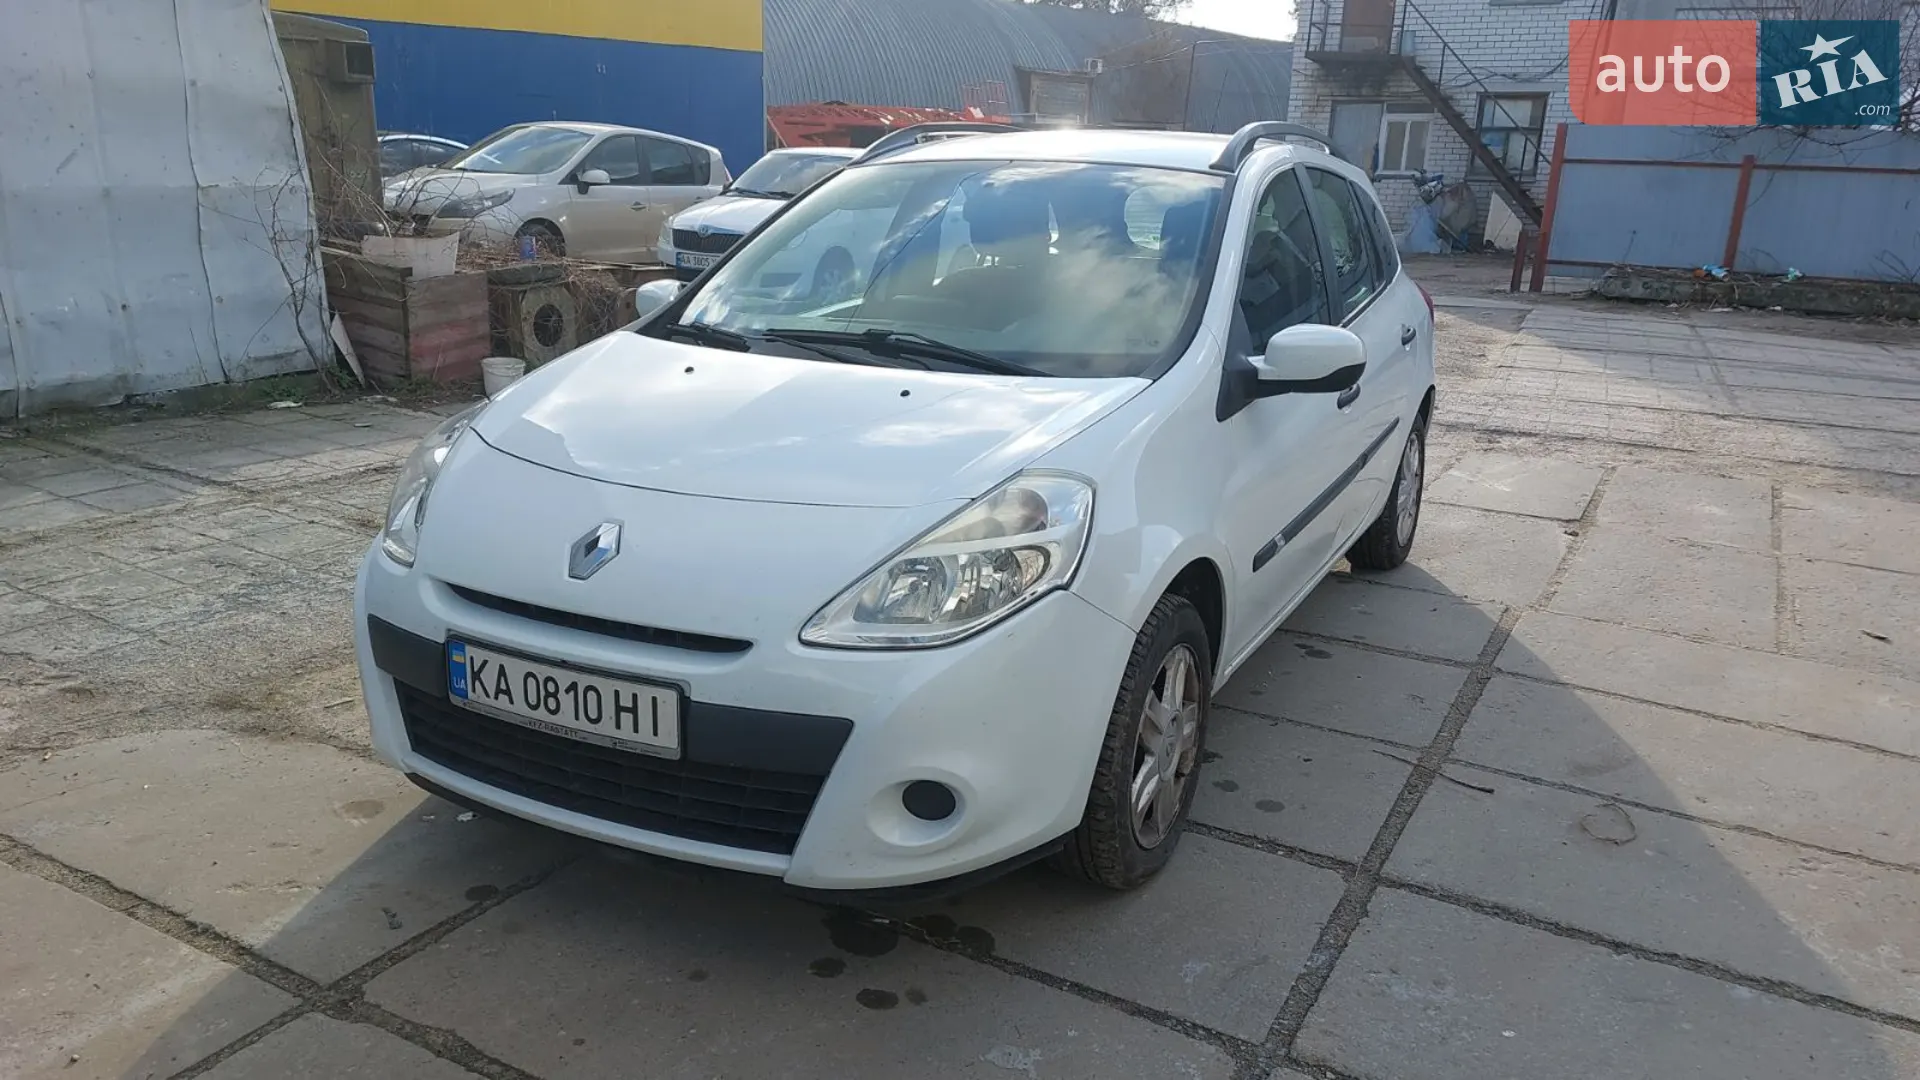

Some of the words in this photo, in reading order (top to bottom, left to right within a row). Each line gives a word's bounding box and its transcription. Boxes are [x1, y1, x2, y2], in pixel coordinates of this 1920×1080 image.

[453, 677, 467, 691] UA
[470, 655, 514, 705] KA
[523, 671, 603, 725] 0810
[614, 689, 659, 737] HI
